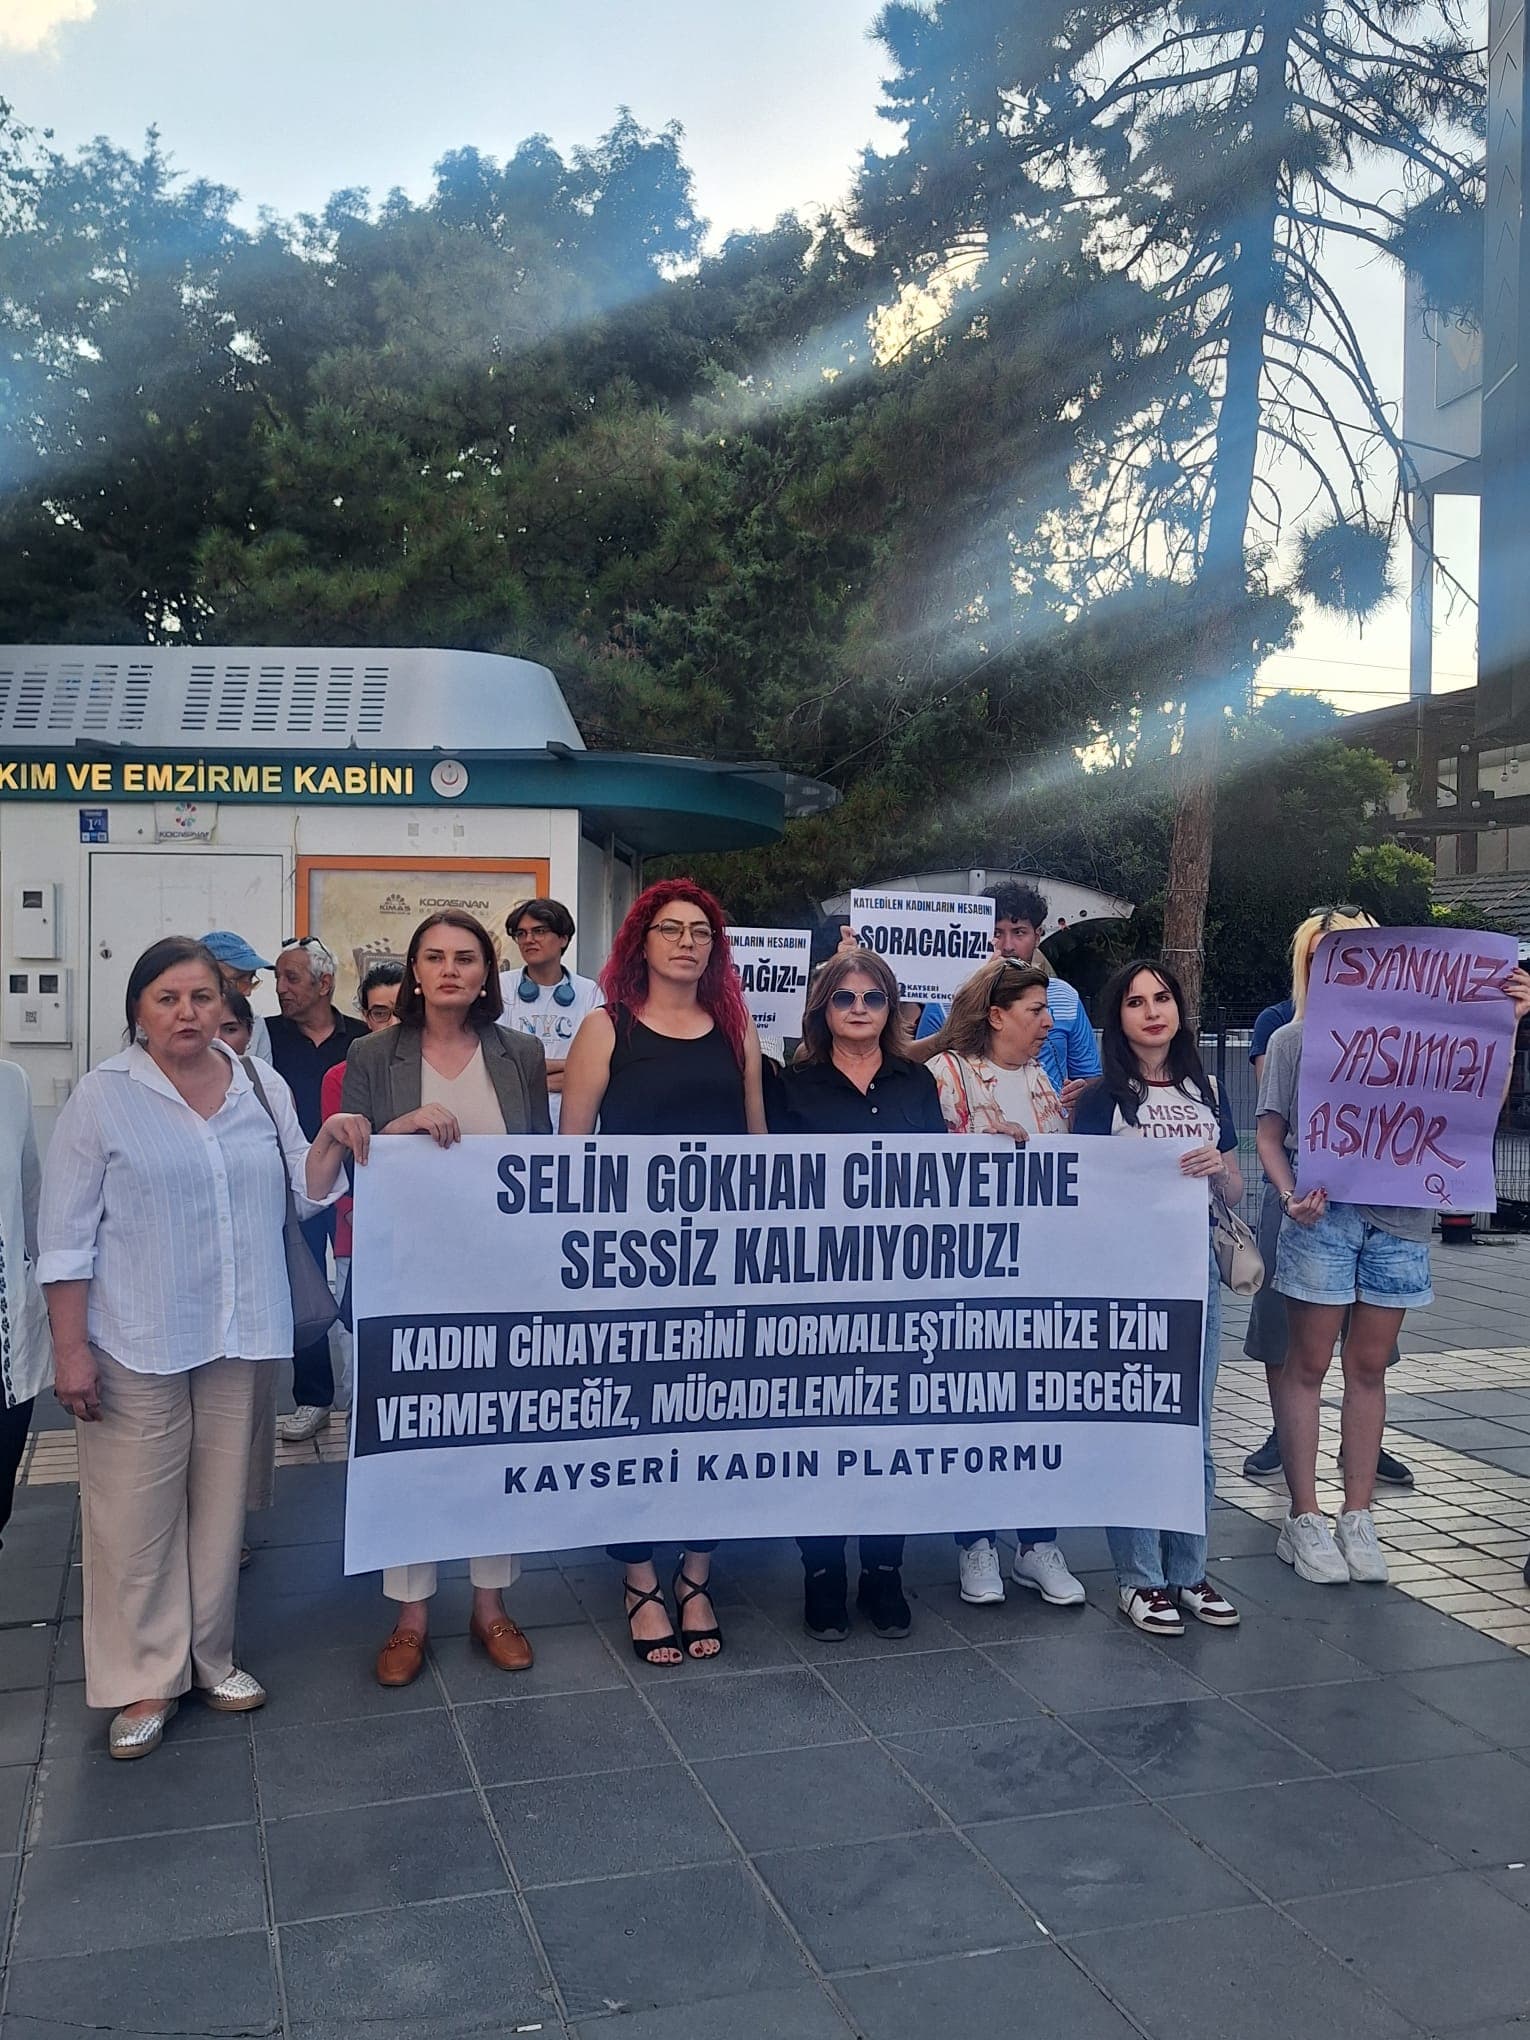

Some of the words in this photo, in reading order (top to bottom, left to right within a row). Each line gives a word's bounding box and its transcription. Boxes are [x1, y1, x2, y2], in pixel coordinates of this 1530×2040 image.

[66, 763, 112, 791] VE
[124, 758, 283, 793] EMZİRME
[853, 897, 903, 910] KATLEDİLEN
[906, 900, 955, 913] KADINLARIN
[957, 903, 993, 916] HESABINI
[767, 937, 807, 949] HESABINI
[861, 923, 988, 959] SORACAĞIZ!
[1324, 936, 1510, 1004] İSYANIMIZ
[907, 992, 928, 1000] EMEK
[1328, 1024, 1498, 1099] YASIMIZI
[1139, 1122, 1216, 1141] TOMMY
[1147, 1104, 1199, 1121] MISS
[1304, 1100, 1467, 1170] AŞIYOR
[496, 1142, 629, 1215] SELİN
[646, 1142, 826, 1213] GÖKHAN
[843, 1140, 1079, 1209] CİNAYETİNE
[560, 1217, 719, 1290] SESSİZ
[733, 1223, 1020, 1286] KALMIYORUZ!
[391, 1325, 498, 1373] KADIN
[508, 1310, 746, 1368] CİNAYETLERİNİ
[754, 1301, 1099, 1365] NORMALLEŞTİRMENİZE
[1109, 1302, 1169, 1351] İZİN
[375, 1377, 641, 1443] VERMEYECEĞİZ,
[651, 1367, 899, 1424] MÜCADELEMİZE
[909, 1371, 1016, 1414] DEVAM
[1026, 1362, 1183, 1414] EDECEĞİZ!
[504, 1449, 680, 1495] KAYSERİ
[697, 1450, 819, 1483] KADIN
[837, 1444, 1063, 1477] PLATFORMU
